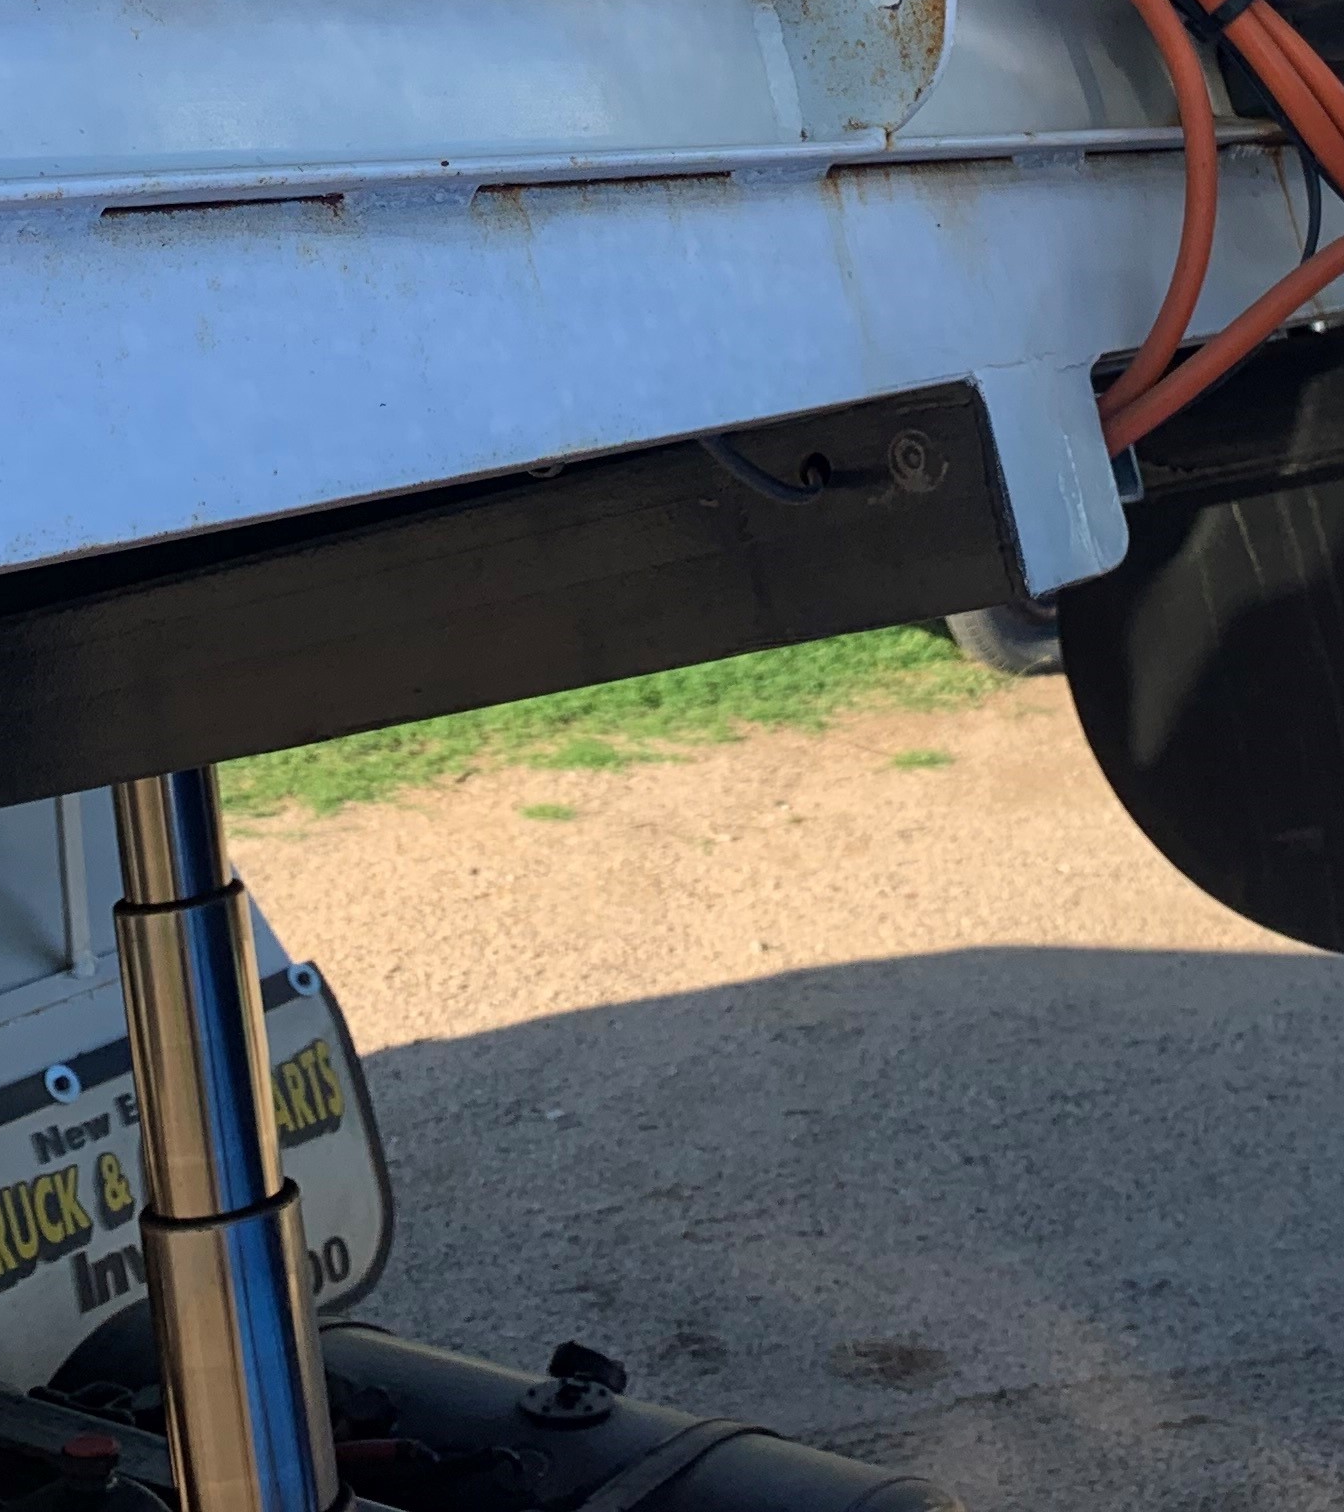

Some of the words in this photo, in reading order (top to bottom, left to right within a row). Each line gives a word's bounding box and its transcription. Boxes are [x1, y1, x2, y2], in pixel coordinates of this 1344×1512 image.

[31, 1112, 110, 1164] New
[95, 1152, 135, 1229] &
[271, 1038, 345, 1144] ARTS
